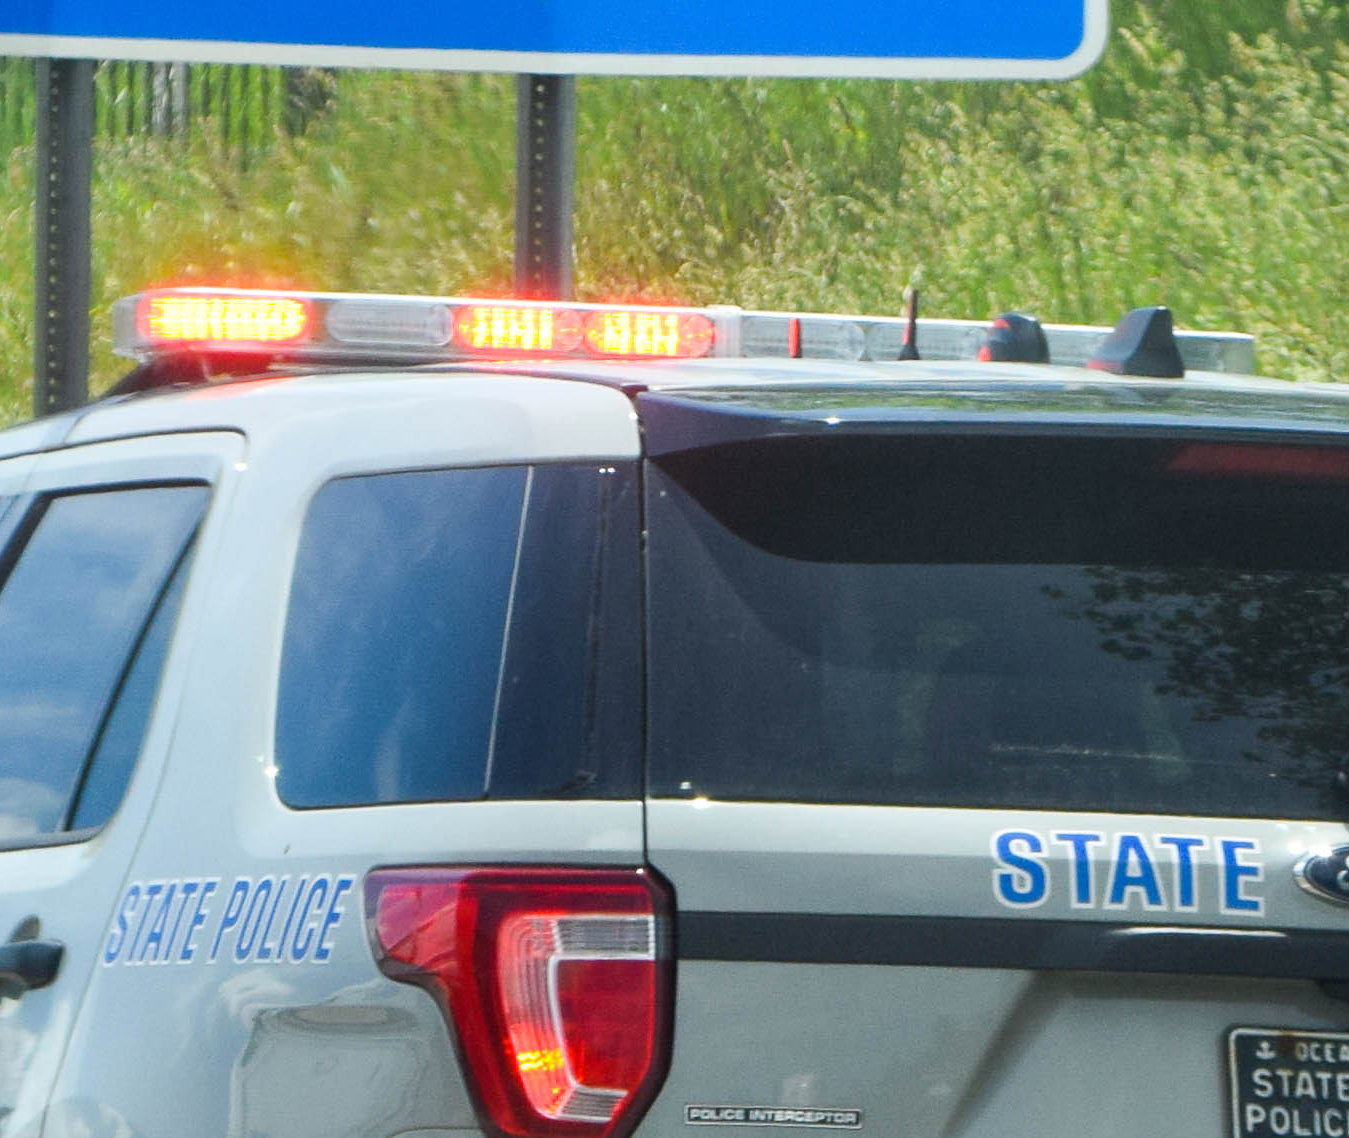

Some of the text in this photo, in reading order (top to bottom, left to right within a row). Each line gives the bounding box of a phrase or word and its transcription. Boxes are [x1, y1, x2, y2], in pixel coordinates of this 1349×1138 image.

[992, 828, 1265, 916] STATE
[103, 874, 356, 967] STATE POLICE
[689, 1108, 857, 1123] POLICE INTERCEPTOR
